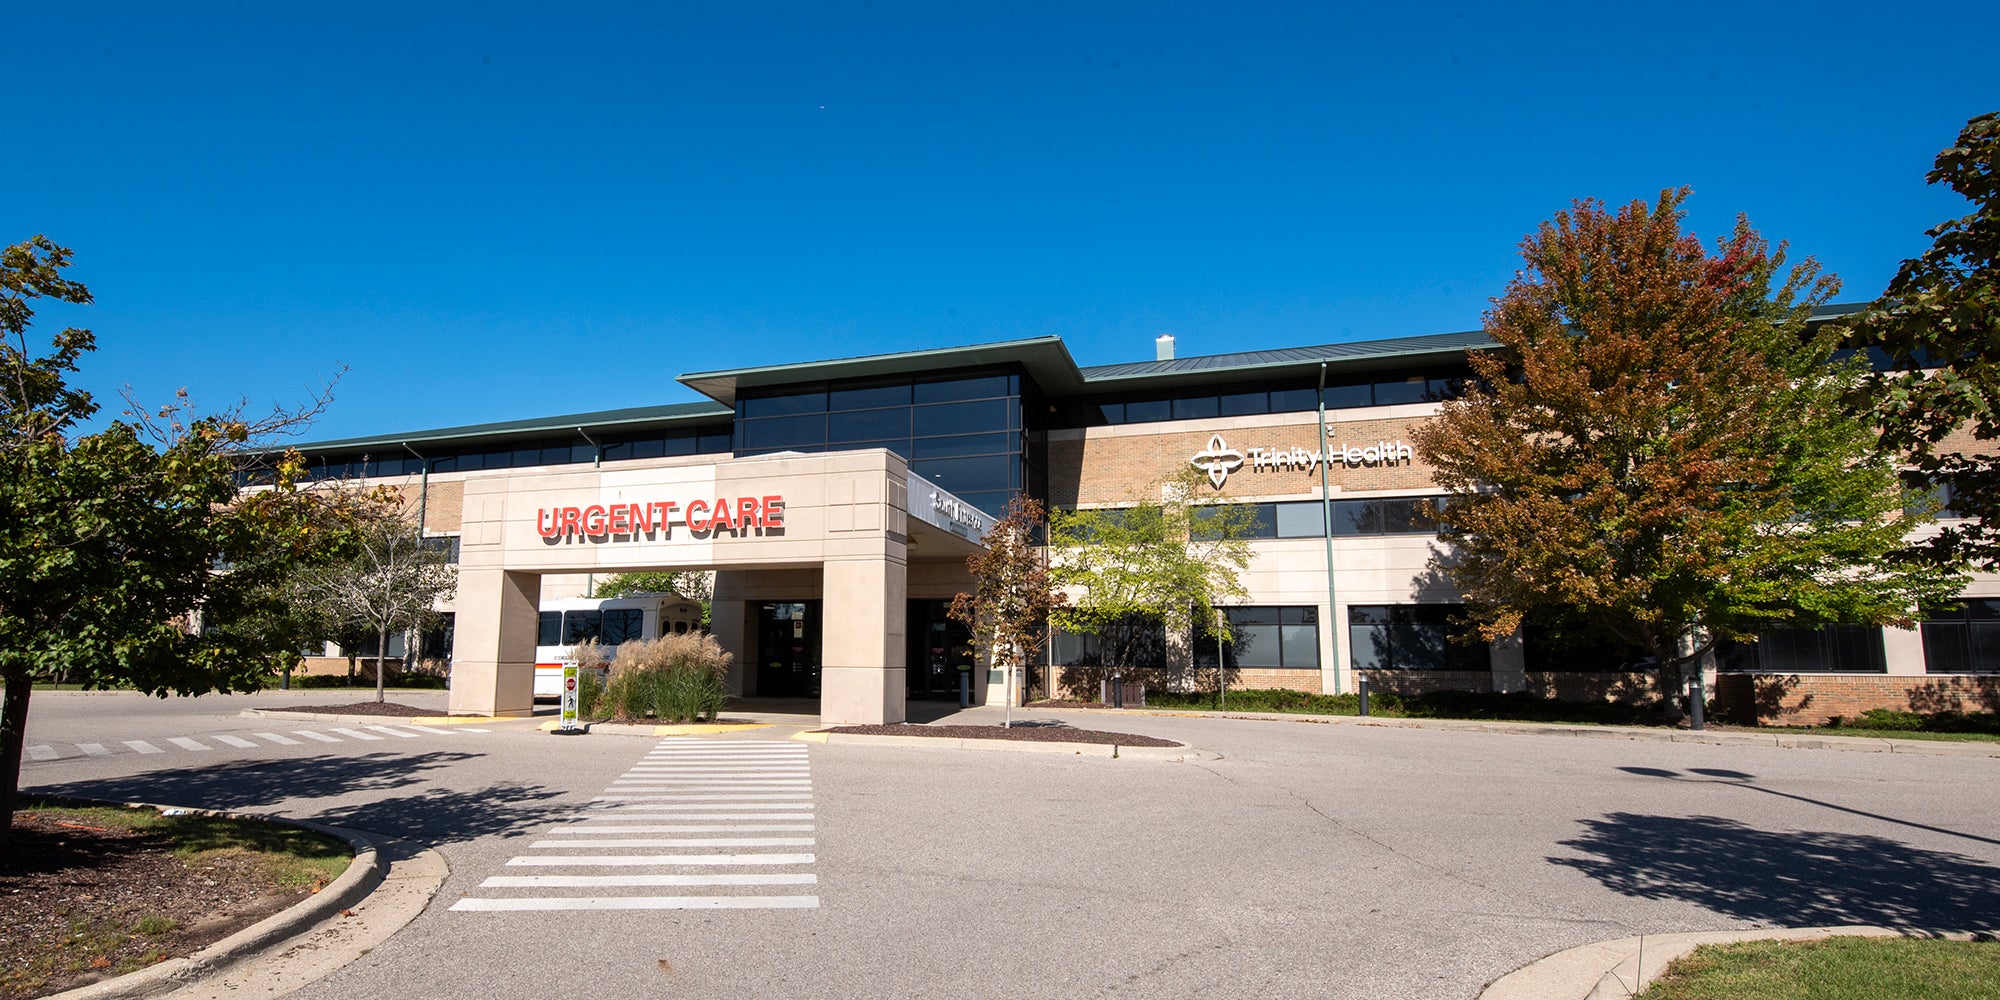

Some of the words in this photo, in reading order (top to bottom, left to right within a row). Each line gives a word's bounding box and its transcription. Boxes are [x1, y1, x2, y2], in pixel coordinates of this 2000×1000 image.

[1247, 446, 1320, 470] Trinity
[1328, 440, 1412, 464] Health
[537, 501, 677, 537] URGENT
[685, 495, 783, 532] CARE
